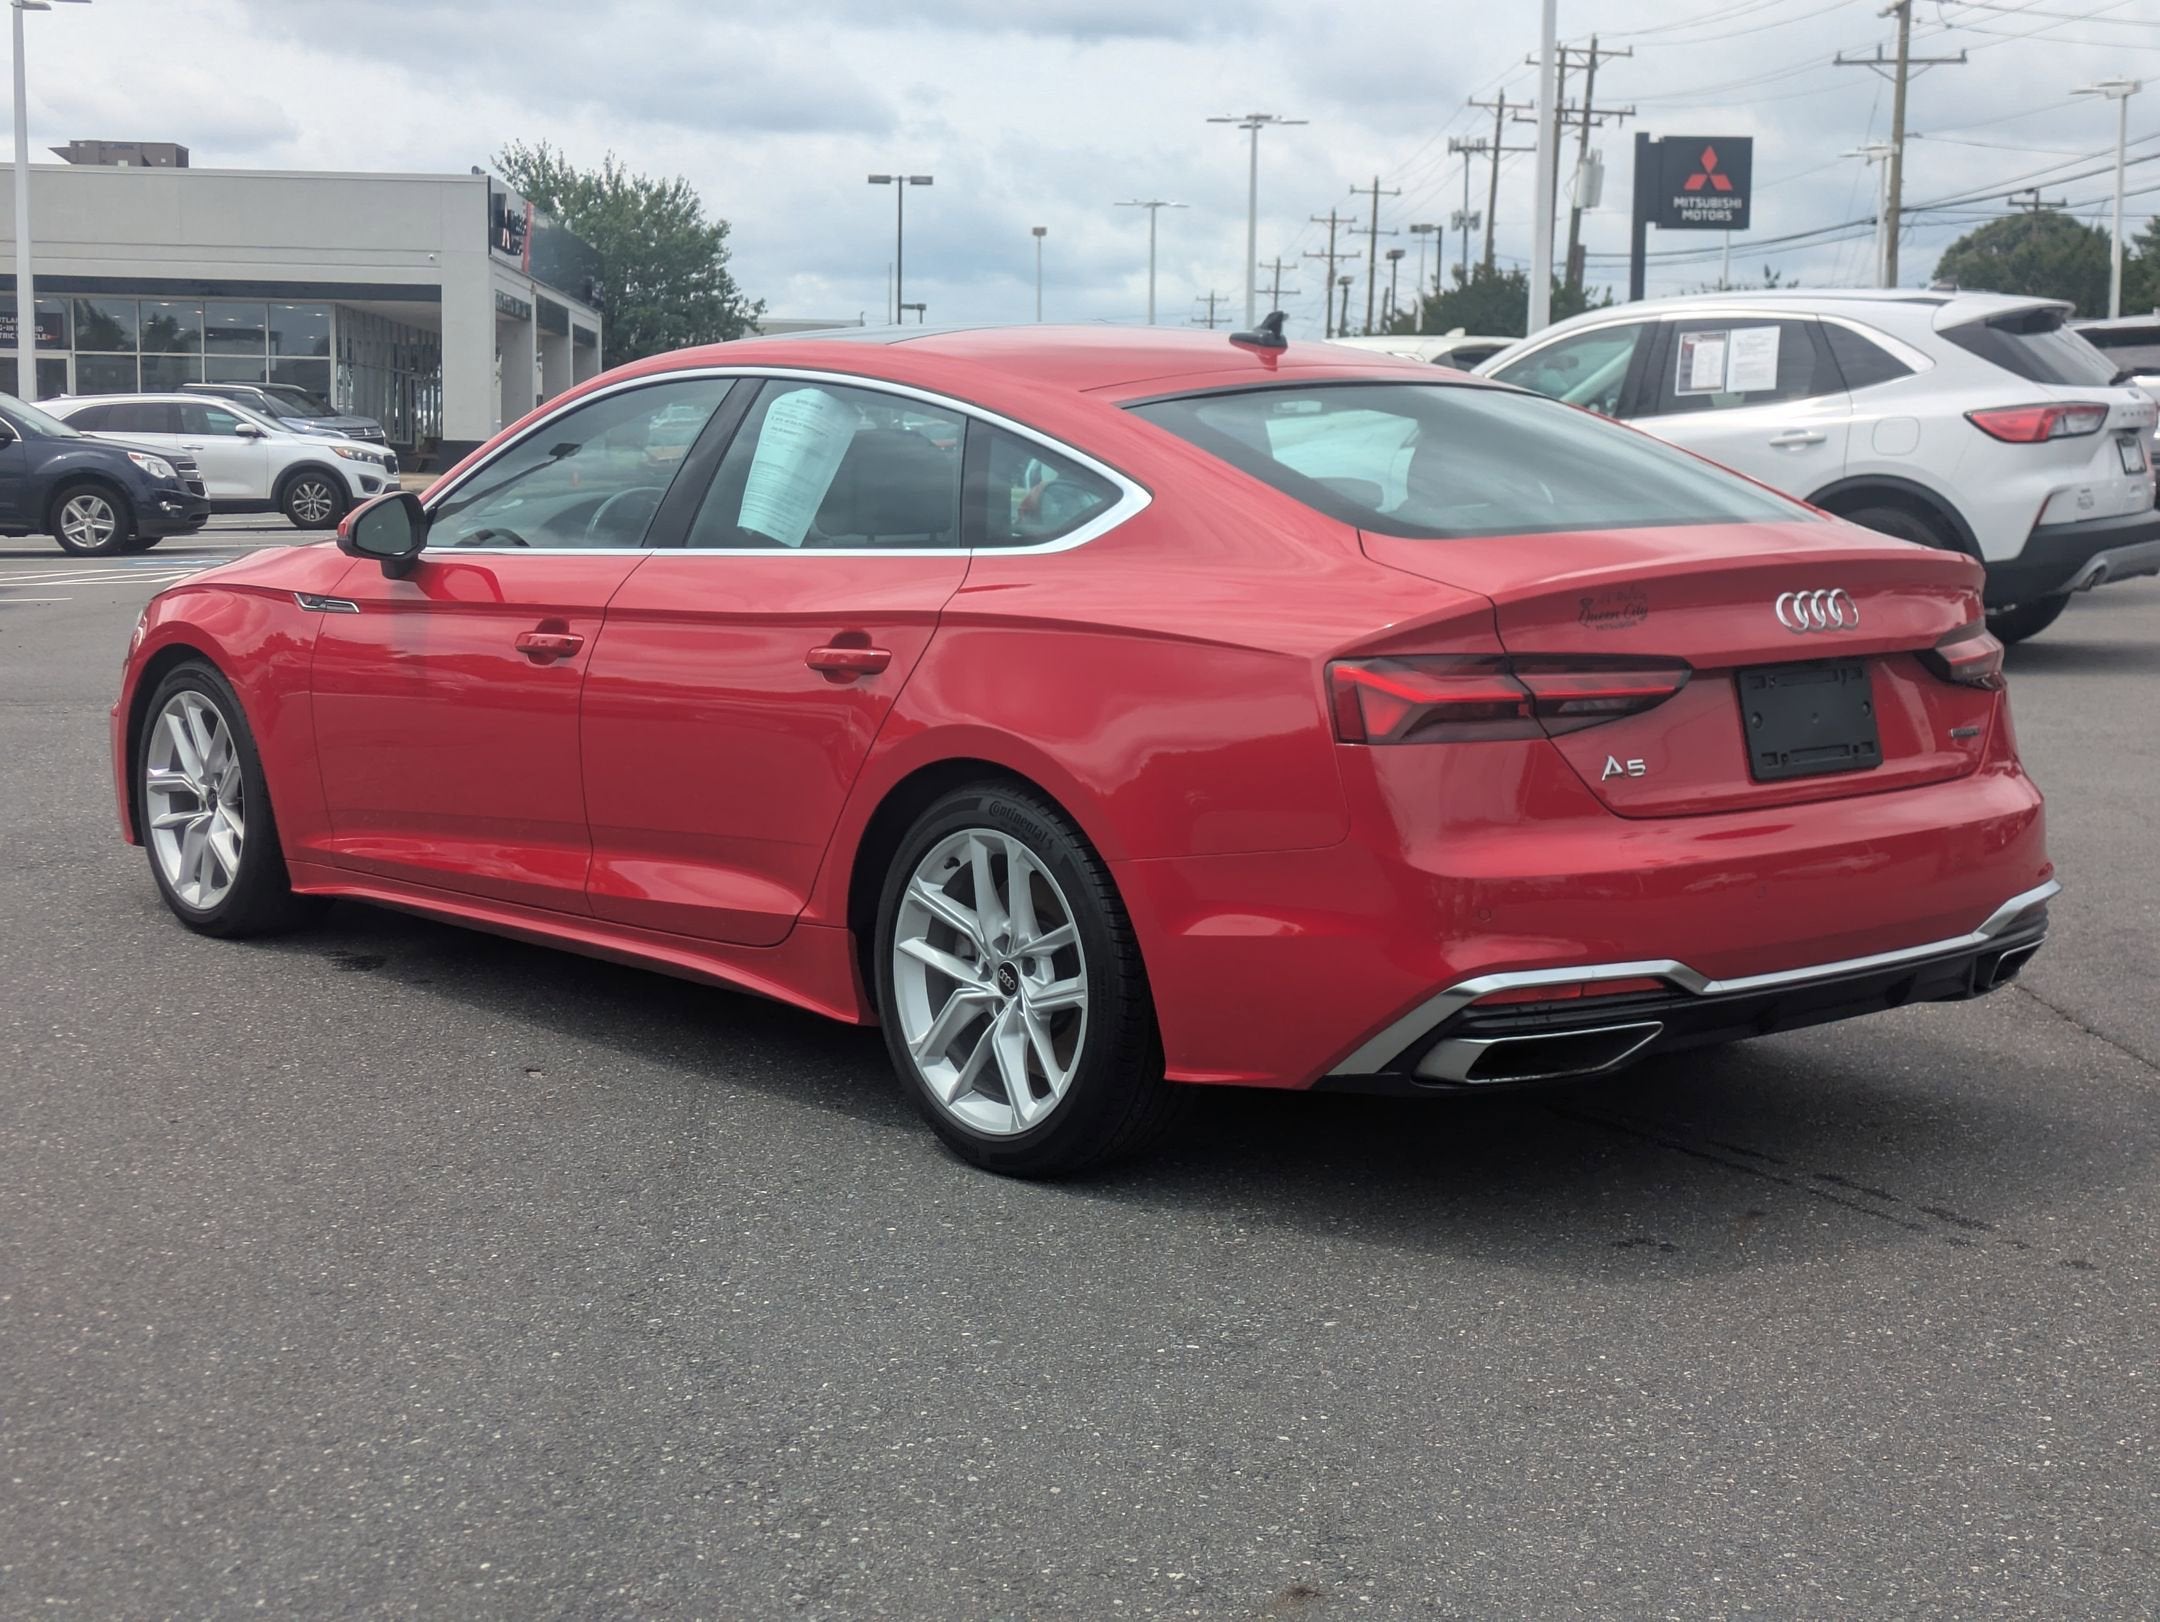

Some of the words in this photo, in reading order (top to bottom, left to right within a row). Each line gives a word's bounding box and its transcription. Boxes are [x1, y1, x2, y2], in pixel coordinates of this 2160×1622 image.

[1673, 197, 1742, 209] MITSUBISHI
[1682, 210, 1732, 221] MOTORS
[1601, 755, 1646, 781] A5
[989, 800, 1048, 841] Continental
